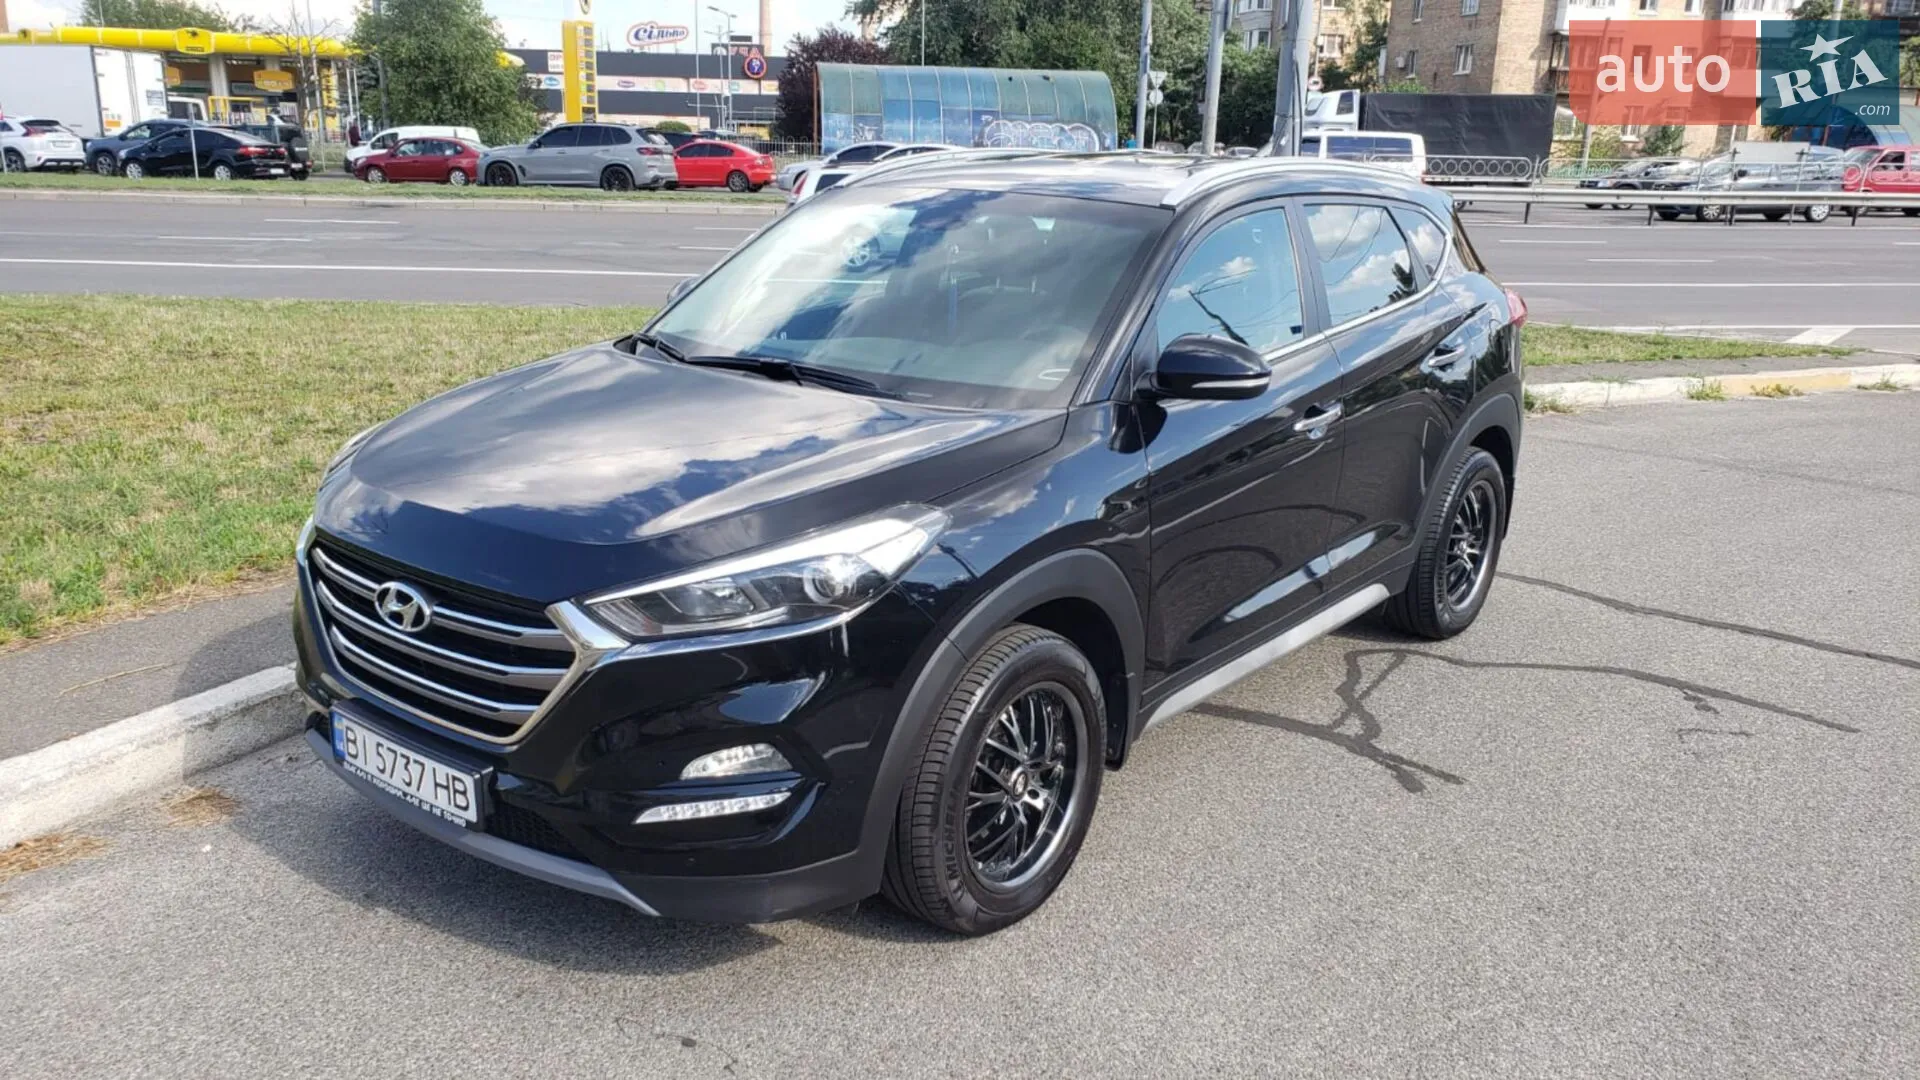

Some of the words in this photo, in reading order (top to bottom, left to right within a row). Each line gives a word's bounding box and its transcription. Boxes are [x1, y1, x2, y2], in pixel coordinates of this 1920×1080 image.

[345, 726, 367, 766] BI
[376, 741, 426, 792] 5737
[433, 767, 470, 812] HB
